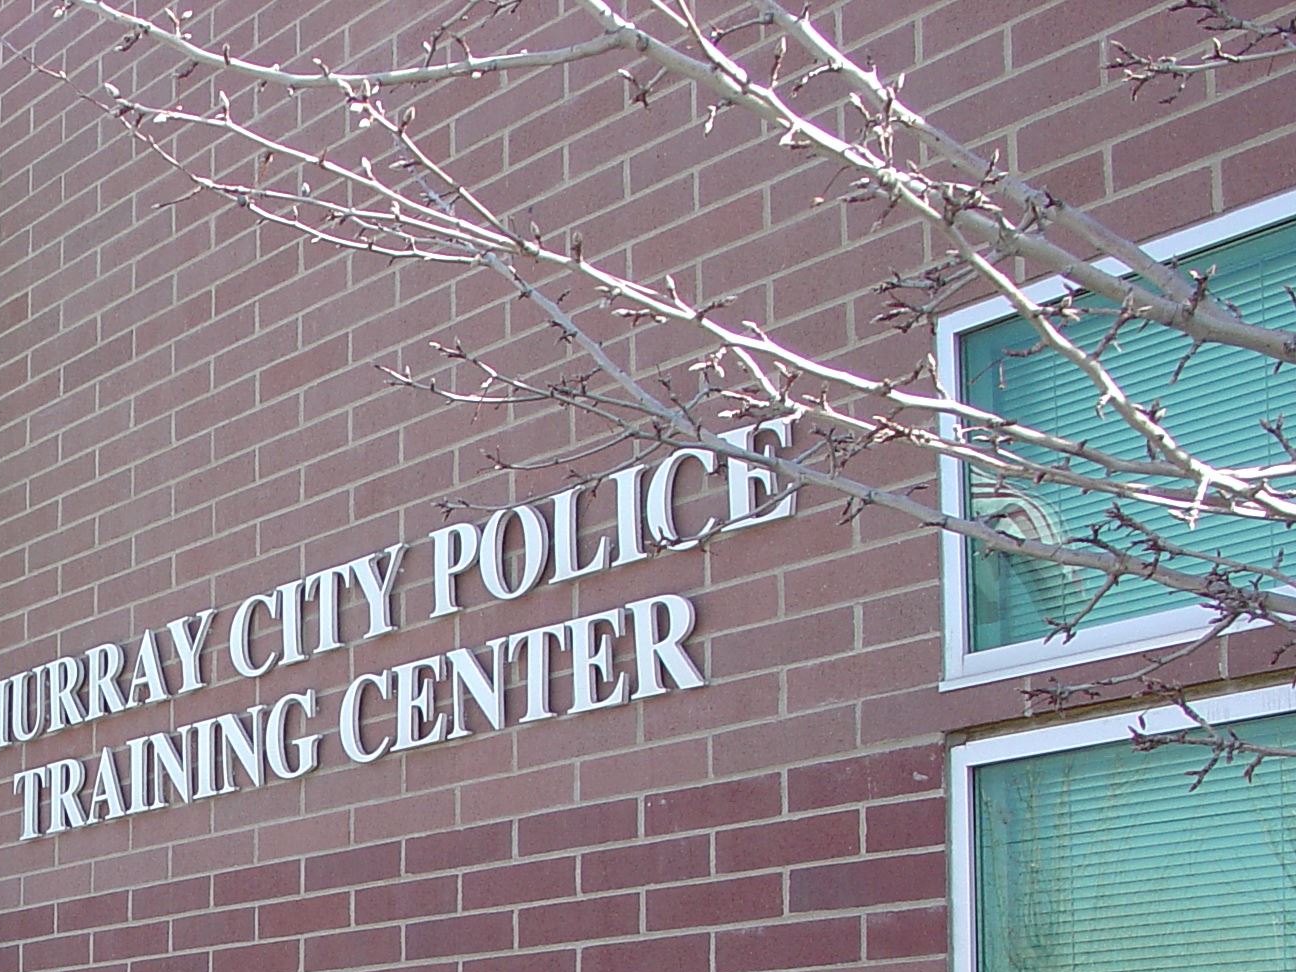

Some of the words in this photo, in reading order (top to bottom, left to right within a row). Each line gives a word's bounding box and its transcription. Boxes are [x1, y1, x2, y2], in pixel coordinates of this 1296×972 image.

[229, 542, 408, 678] CITY
[429, 417, 799, 618] POLICE
[14, 688, 321, 842] TRAINING
[339, 593, 707, 764] CENTER
